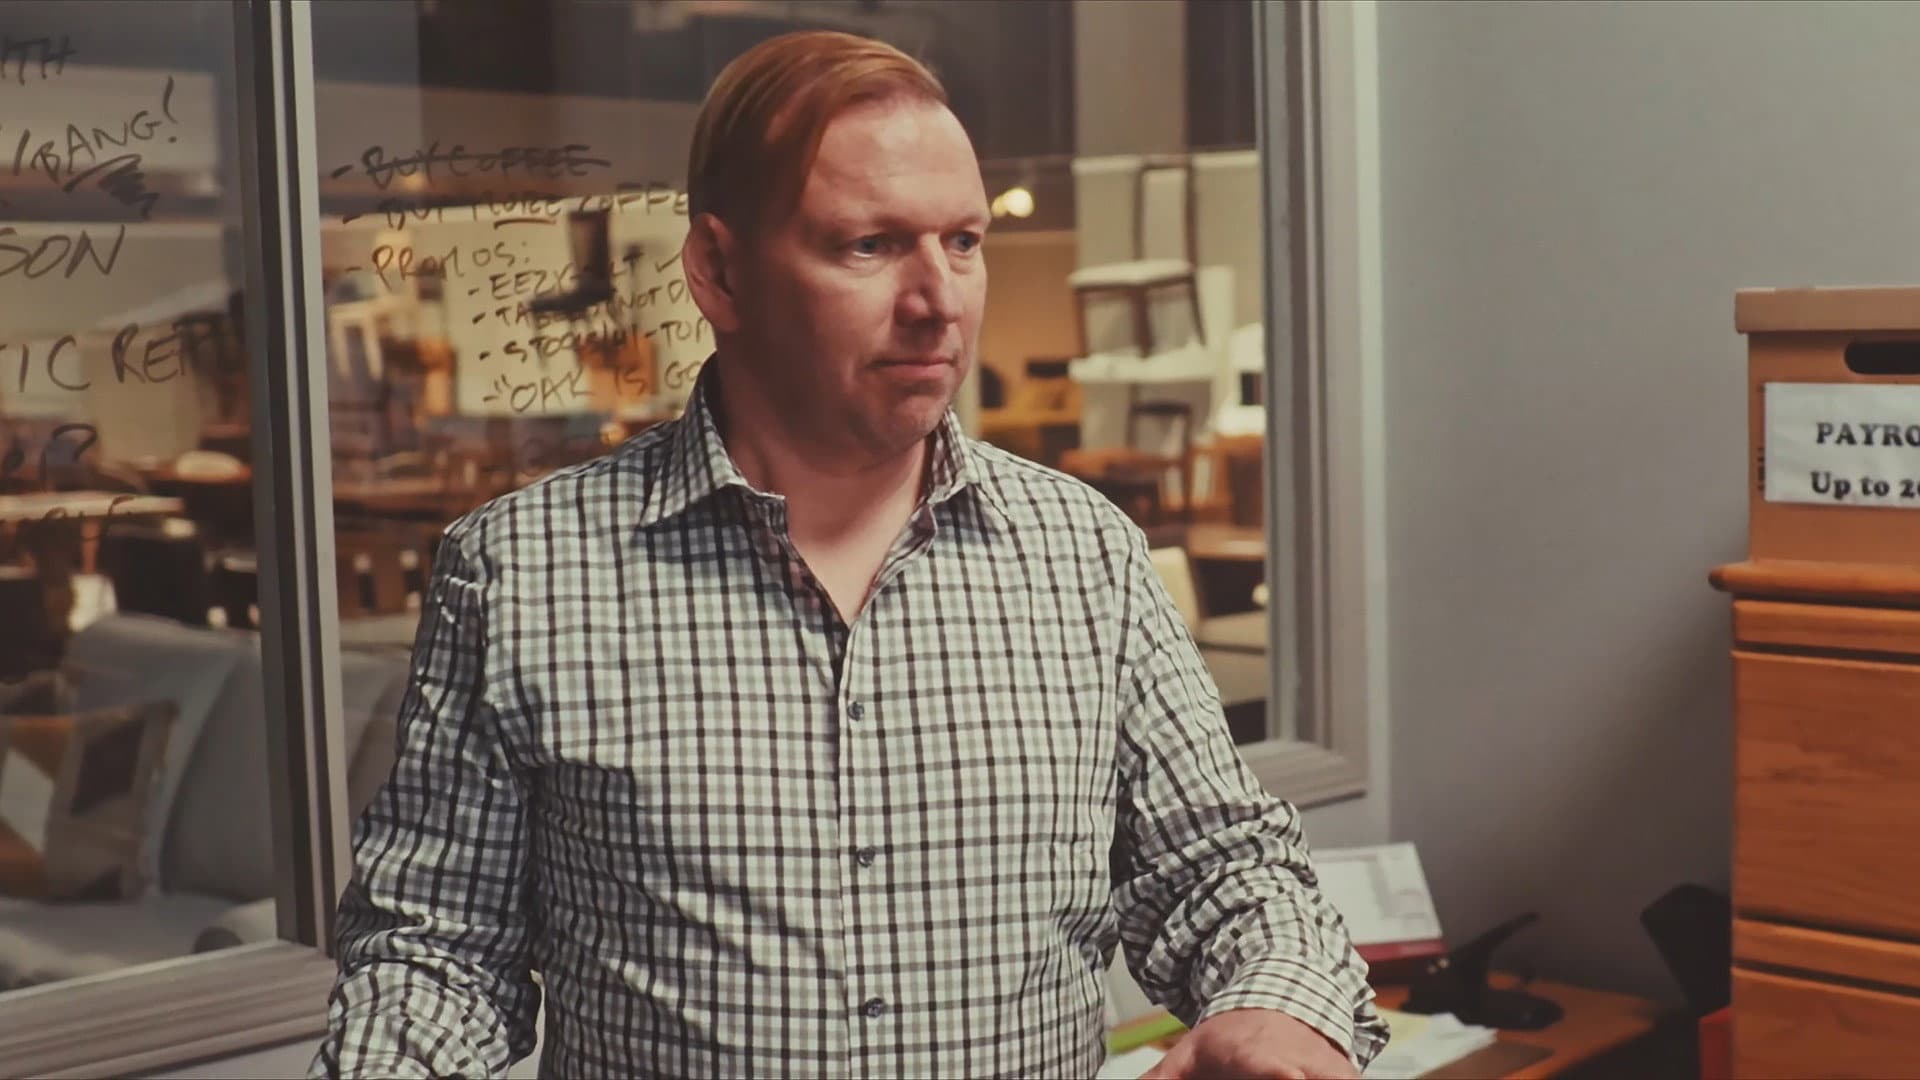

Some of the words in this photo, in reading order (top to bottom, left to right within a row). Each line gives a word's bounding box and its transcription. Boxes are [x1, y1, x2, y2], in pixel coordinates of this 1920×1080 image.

[0, 334, 91, 393] IC
[1810, 470, 1851, 501] Up
[1860, 476, 1890, 498] to
[1899, 478, 1920, 499] 2
